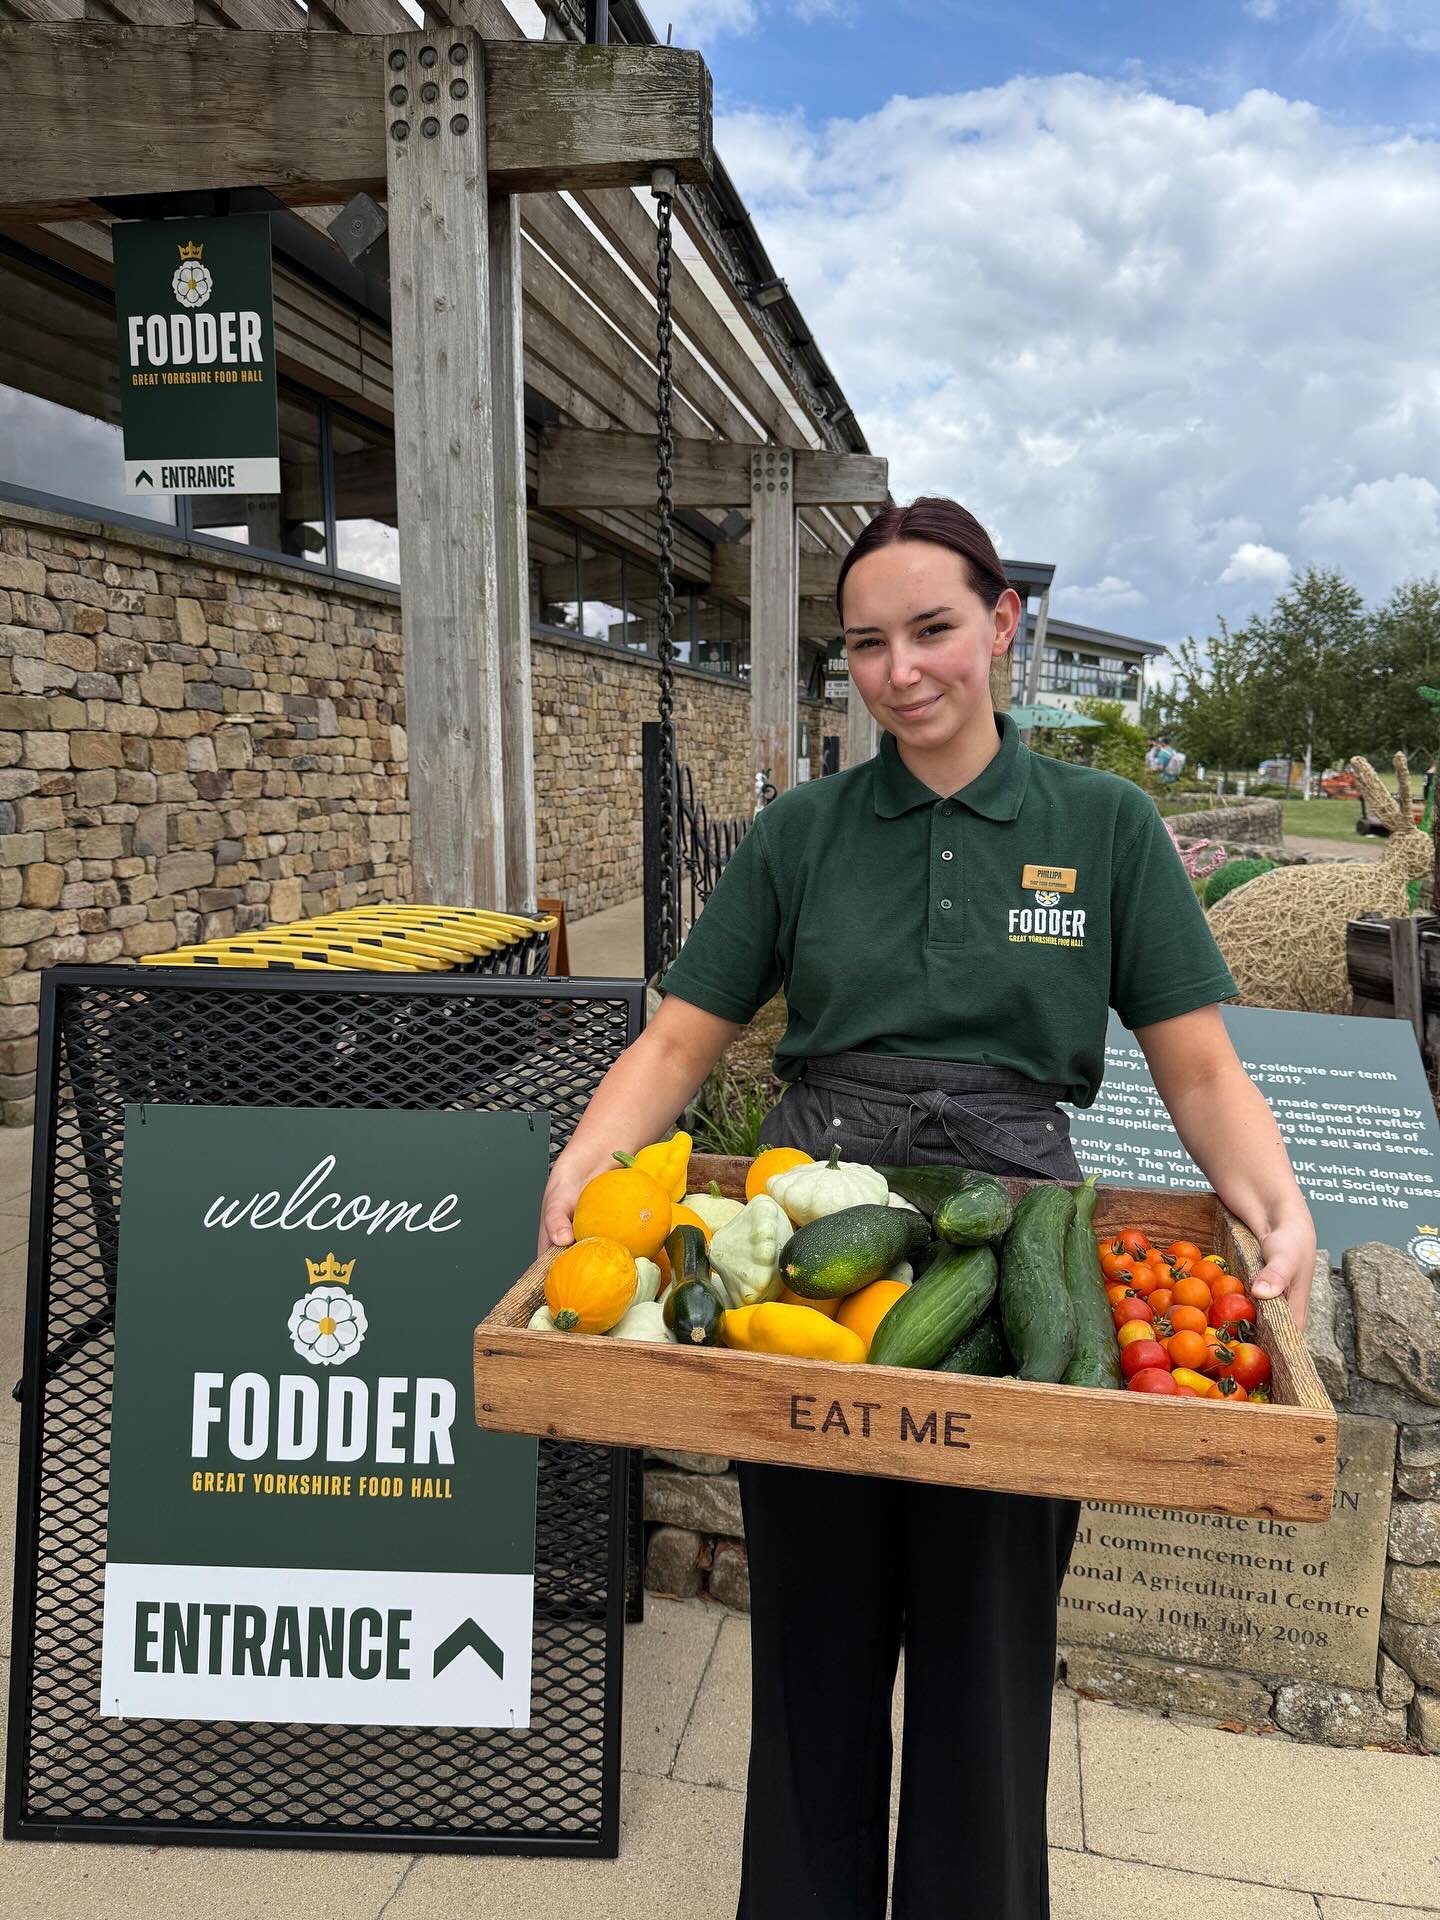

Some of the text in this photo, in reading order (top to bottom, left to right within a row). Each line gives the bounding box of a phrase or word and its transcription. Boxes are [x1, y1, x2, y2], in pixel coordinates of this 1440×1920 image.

[128, 311, 264, 367] FODDER
[132, 370, 264, 386] GREAT YORKSHIRE FOOD HALL
[161, 465, 236, 489] ENTRANCE
[1008, 908, 1086, 937] FODDER
[1008, 934, 1084, 947] GREAT YORKSHIRE FOOD HALL
[1242, 1061, 1256, 1069] to
[1260, 1063, 1327, 1075] celebrate
[1330, 1069, 1355, 1077] our
[1358, 1070, 1397, 1081] tenth
[1250, 1073, 1264, 1081] of
[1267, 1073, 1306, 1085] 2019.
[1106, 1093, 1143, 1105] wire.
[1285, 1110, 1353, 1124] designed
[1356, 1116, 1372, 1125] to
[1375, 1119, 1426, 1130] reflect
[1136, 1108, 1150, 1117] of
[1298, 1123, 1324, 1134] the
[1327, 1125, 1400, 1140] hundreds
[1403, 1132, 1419, 1142] of
[1277, 1099, 1318, 1109] made
[1321, 1102, 1400, 1117] everything
[1403, 1107, 1422, 1119] by
[1077, 1113, 1104, 1123] and
[1107, 1117, 1176, 1133] suppliers
[1282, 1136, 1291, 1144] e
[1294, 1137, 1317, 1146] we
[1320, 1139, 1350, 1149] sell
[1352, 1142, 1382, 1152] and
[1385, 1143, 1434, 1157] serve.
[1074, 1150, 1128, 1166] charity.
[1136, 1157, 1164, 1170] The
[1167, 1161, 1203, 1174] York
[1342, 1179, 1400, 1195] Society
[1404, 1186, 1440, 1198] uses
[1081, 1138, 1112, 1151] only
[1114, 1142, 1150, 1155] shop
[1153, 1148, 1182, 1159] and
[1292, 1160, 1317, 1173] UK
[1319, 1164, 1366, 1177] which
[1369, 1168, 1434, 1183] donates
[203, 1155, 462, 1235] welcome
[1137, 1173, 1166, 1184] and
[1309, 1190, 1345, 1203] food
[1348, 1195, 1378, 1206] and
[1382, 1197, 1408, 1209] the
[191, 1372, 456, 1464] FODDER
[790, 1394, 972, 1449] EAT ME
[192, 1471, 452, 1499] GREAT YORKSHIRE FOOD HALL
[1081, 1500, 1297, 1538] ommemorate the
[1100, 1534, 1294, 1573] commencement
[1302, 1561, 1330, 1578] of
[1132, 1570, 1277, 1605] Agricultural
[1285, 1593, 1369, 1619] Centre
[133, 1600, 413, 1682] ENTRANCE
[1157, 1607, 1207, 1630] 10th
[1216, 1617, 1266, 1641] July
[1273, 1625, 1329, 1648] 2008
